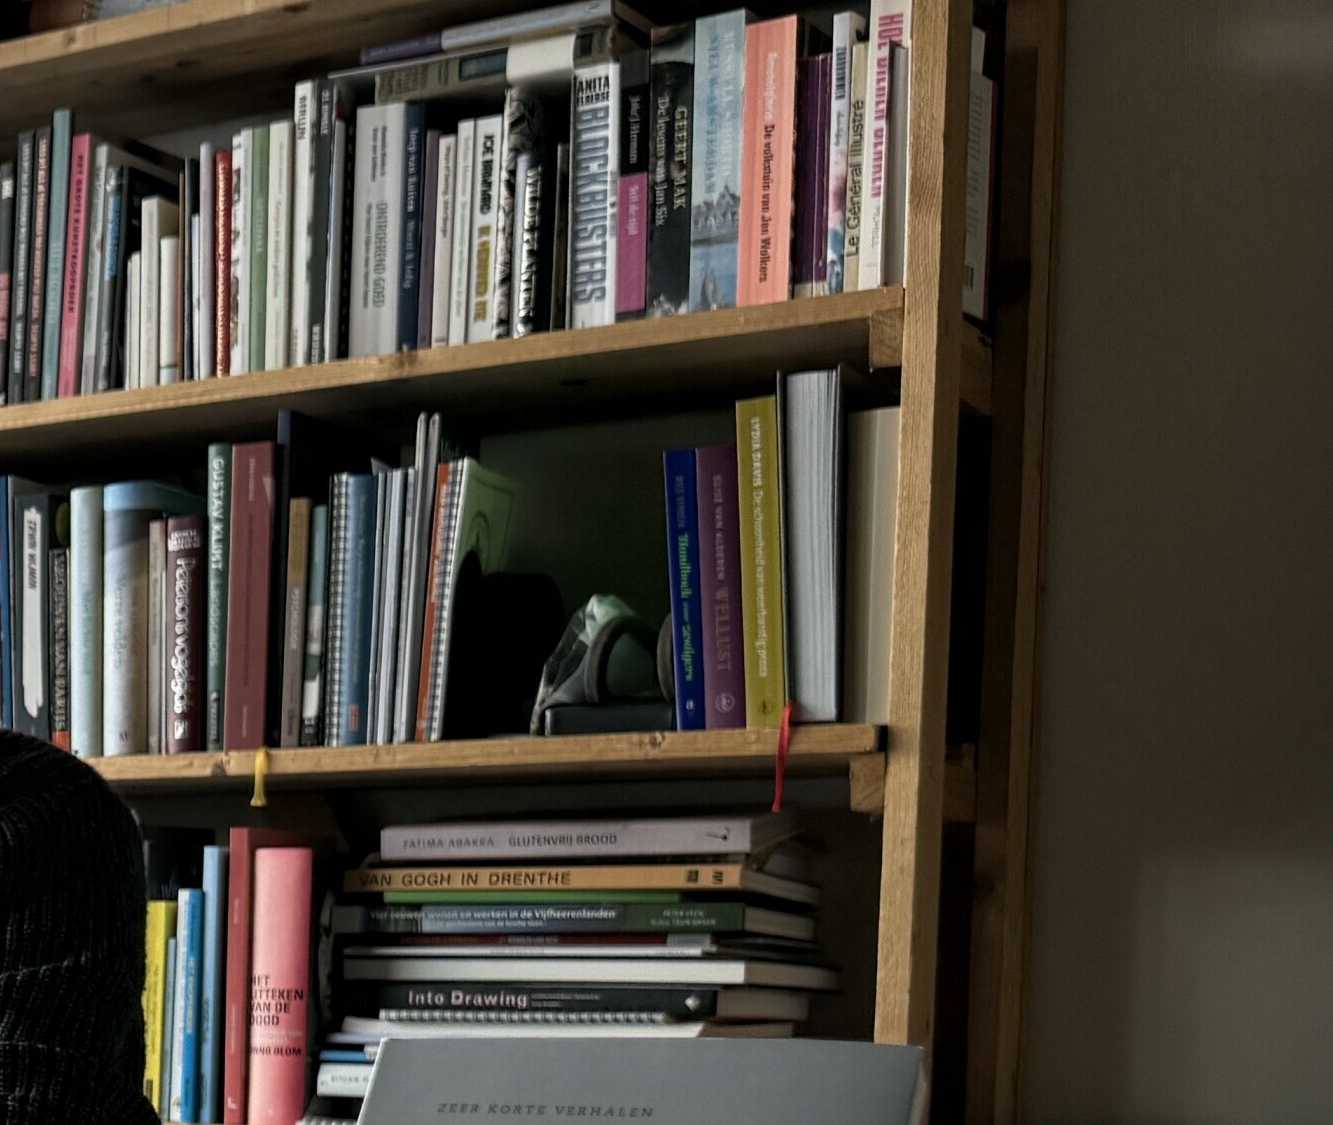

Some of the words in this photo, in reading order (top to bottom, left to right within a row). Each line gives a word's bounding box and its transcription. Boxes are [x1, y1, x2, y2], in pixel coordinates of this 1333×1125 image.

[576, 76, 610, 94] ANITA
[658, 96, 670, 115] De
[673, 106, 688, 163] GEERT
[764, 125, 775, 140] De
[482, 135, 496, 157] JOE
[654, 158, 666, 182] van
[762, 142, 774, 191] volkstuin
[73, 179, 84, 214] GROTE
[672, 171, 687, 210] MAK
[846, 163, 864, 230] Général
[574, 105, 610, 306] BLOCKBUSTERS
[760, 194, 770, 213] van
[760, 216, 772, 235] Jan
[372, 201, 389, 275] ONTROEREND
[846, 237, 859, 256] Le
[758, 238, 772, 283] Wolkers
[371, 277, 386, 308] GOED
[751, 416, 761, 452] LYDIA
[752, 453, 763, 487] DAVIS
[211, 458, 225, 519] GUSTAV
[210, 525, 224, 572] KLIMT
[715, 586, 731, 672] WELLUST
[55, 677, 67, 730] PARIJS
[403, 837, 443, 850] FATIMA
[508, 834, 574, 848] GLUTENVRIJ
[576, 833, 617, 846] BROOD
[359, 872, 392, 887] VAN
[401, 871, 451, 887] GOGH
[460, 871, 478, 886] IN
[488, 870, 571, 886] DRENTHE
[473, 909, 507, 920] werken
[508, 908, 519, 919] in
[520, 908, 533, 919] de
[534, 907, 616, 920] Vijfheerenlanden
[252, 987, 304, 1001] ITTEKEN
[408, 988, 444, 1006] Into
[450, 988, 528, 1010] Drawing
[275, 1002, 291, 1014] DE
[251, 1046, 271, 1057] NNO
[273, 1046, 303, 1058] BLOM
[437, 1101, 479, 1114] ZEER
[487, 1102, 546, 1116] KORTE
[554, 1104, 655, 1119] VERHALEN
